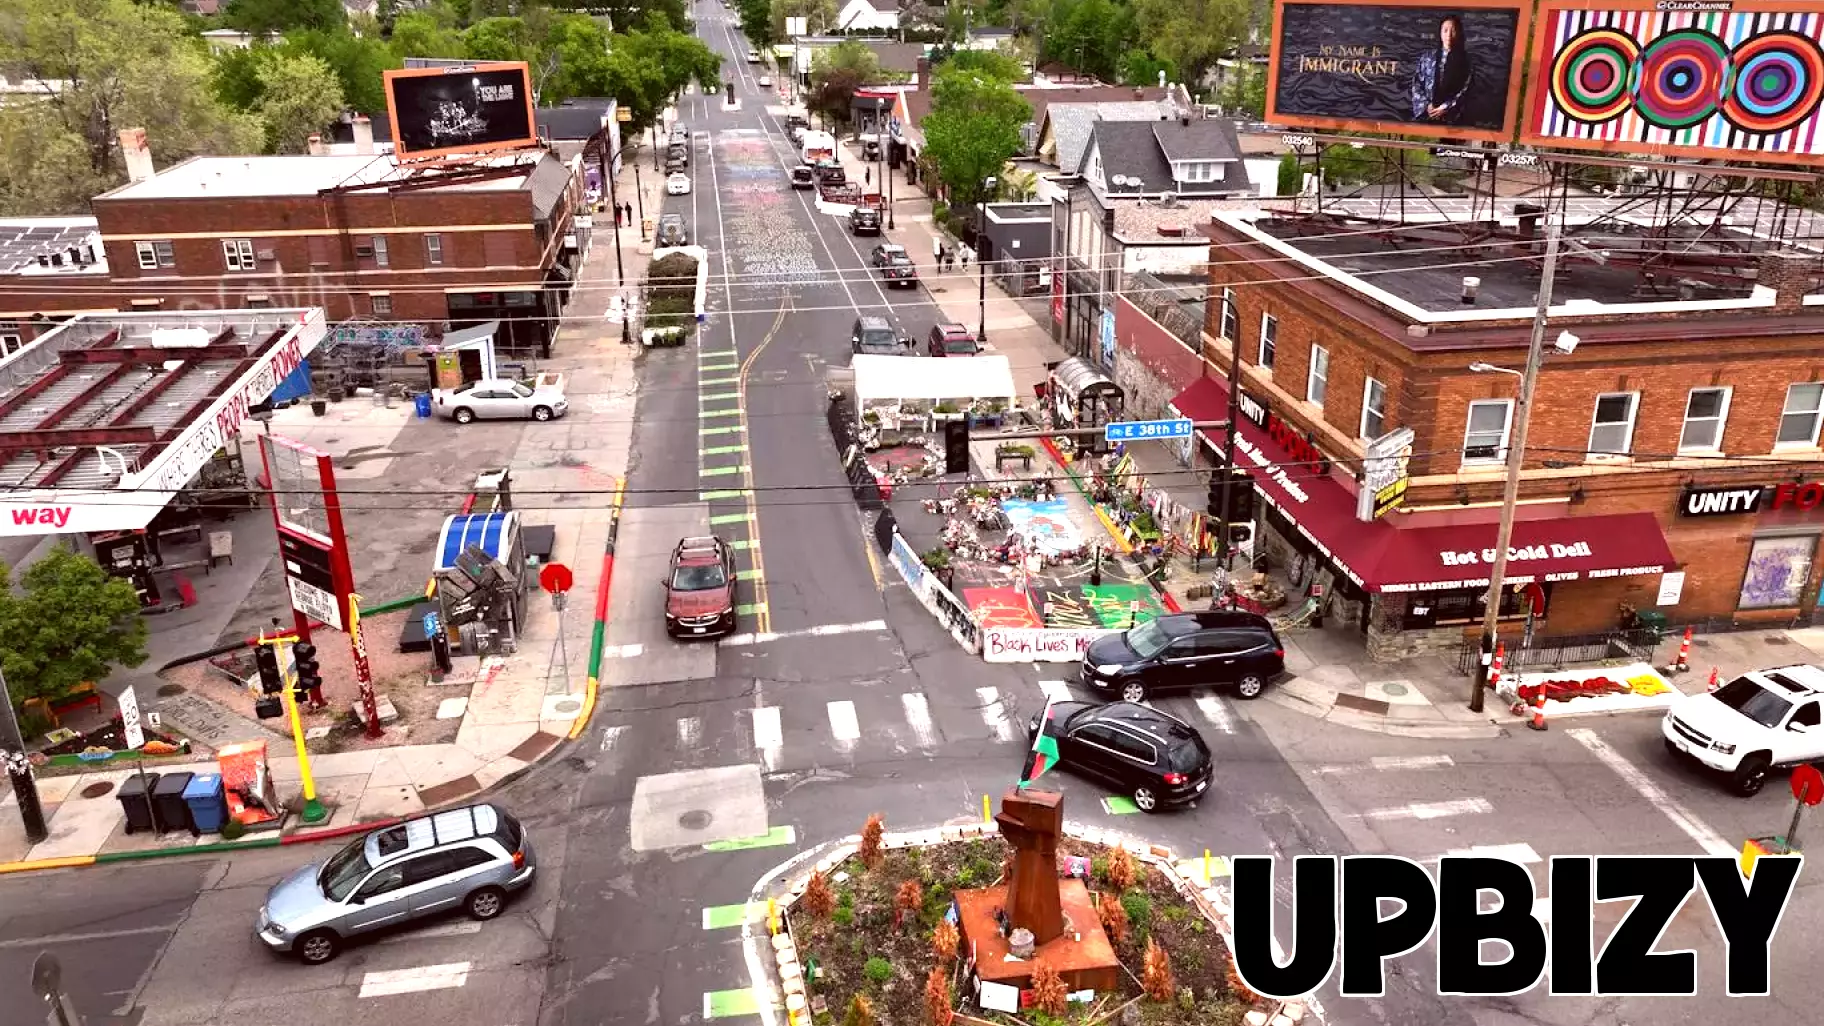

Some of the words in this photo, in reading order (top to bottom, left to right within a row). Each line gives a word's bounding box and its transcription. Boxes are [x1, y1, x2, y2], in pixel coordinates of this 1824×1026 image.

[1319, 44, 1334, 56] MY
[1339, 45, 1366, 57] NAME
[1371, 45, 1381, 57] IS
[1299, 54, 1399, 82] IMMIGRANT
[480, 85, 497, 94] YOU
[1282, 135, 1313, 146] 032540
[1239, 393, 1265, 426] UNITY
[1124, 425, 1134, 437] E
[1139, 424, 1171, 436] 38th
[1175, 422, 1190, 434] St
[1688, 490, 1760, 514] UNITY
[12, 506, 72, 528] way
[1440, 551, 1479, 566] Hot
[1482, 548, 1497, 563] &
[1506, 544, 1549, 562] Cold
[1550, 541, 1593, 558] Deli
[1380, 583, 1417, 593] MIDDLE
[1418, 580, 1462, 591] EASTERN
[1463, 578, 1490, 588] FOOD
[1545, 571, 1579, 582] OLIVES
[1588, 568, 1619, 578] FRESH
[1620, 565, 1664, 576] PRODUCE
[1035, 636, 1069, 652] Lives
[1075, 637, 1093, 653] Ma
